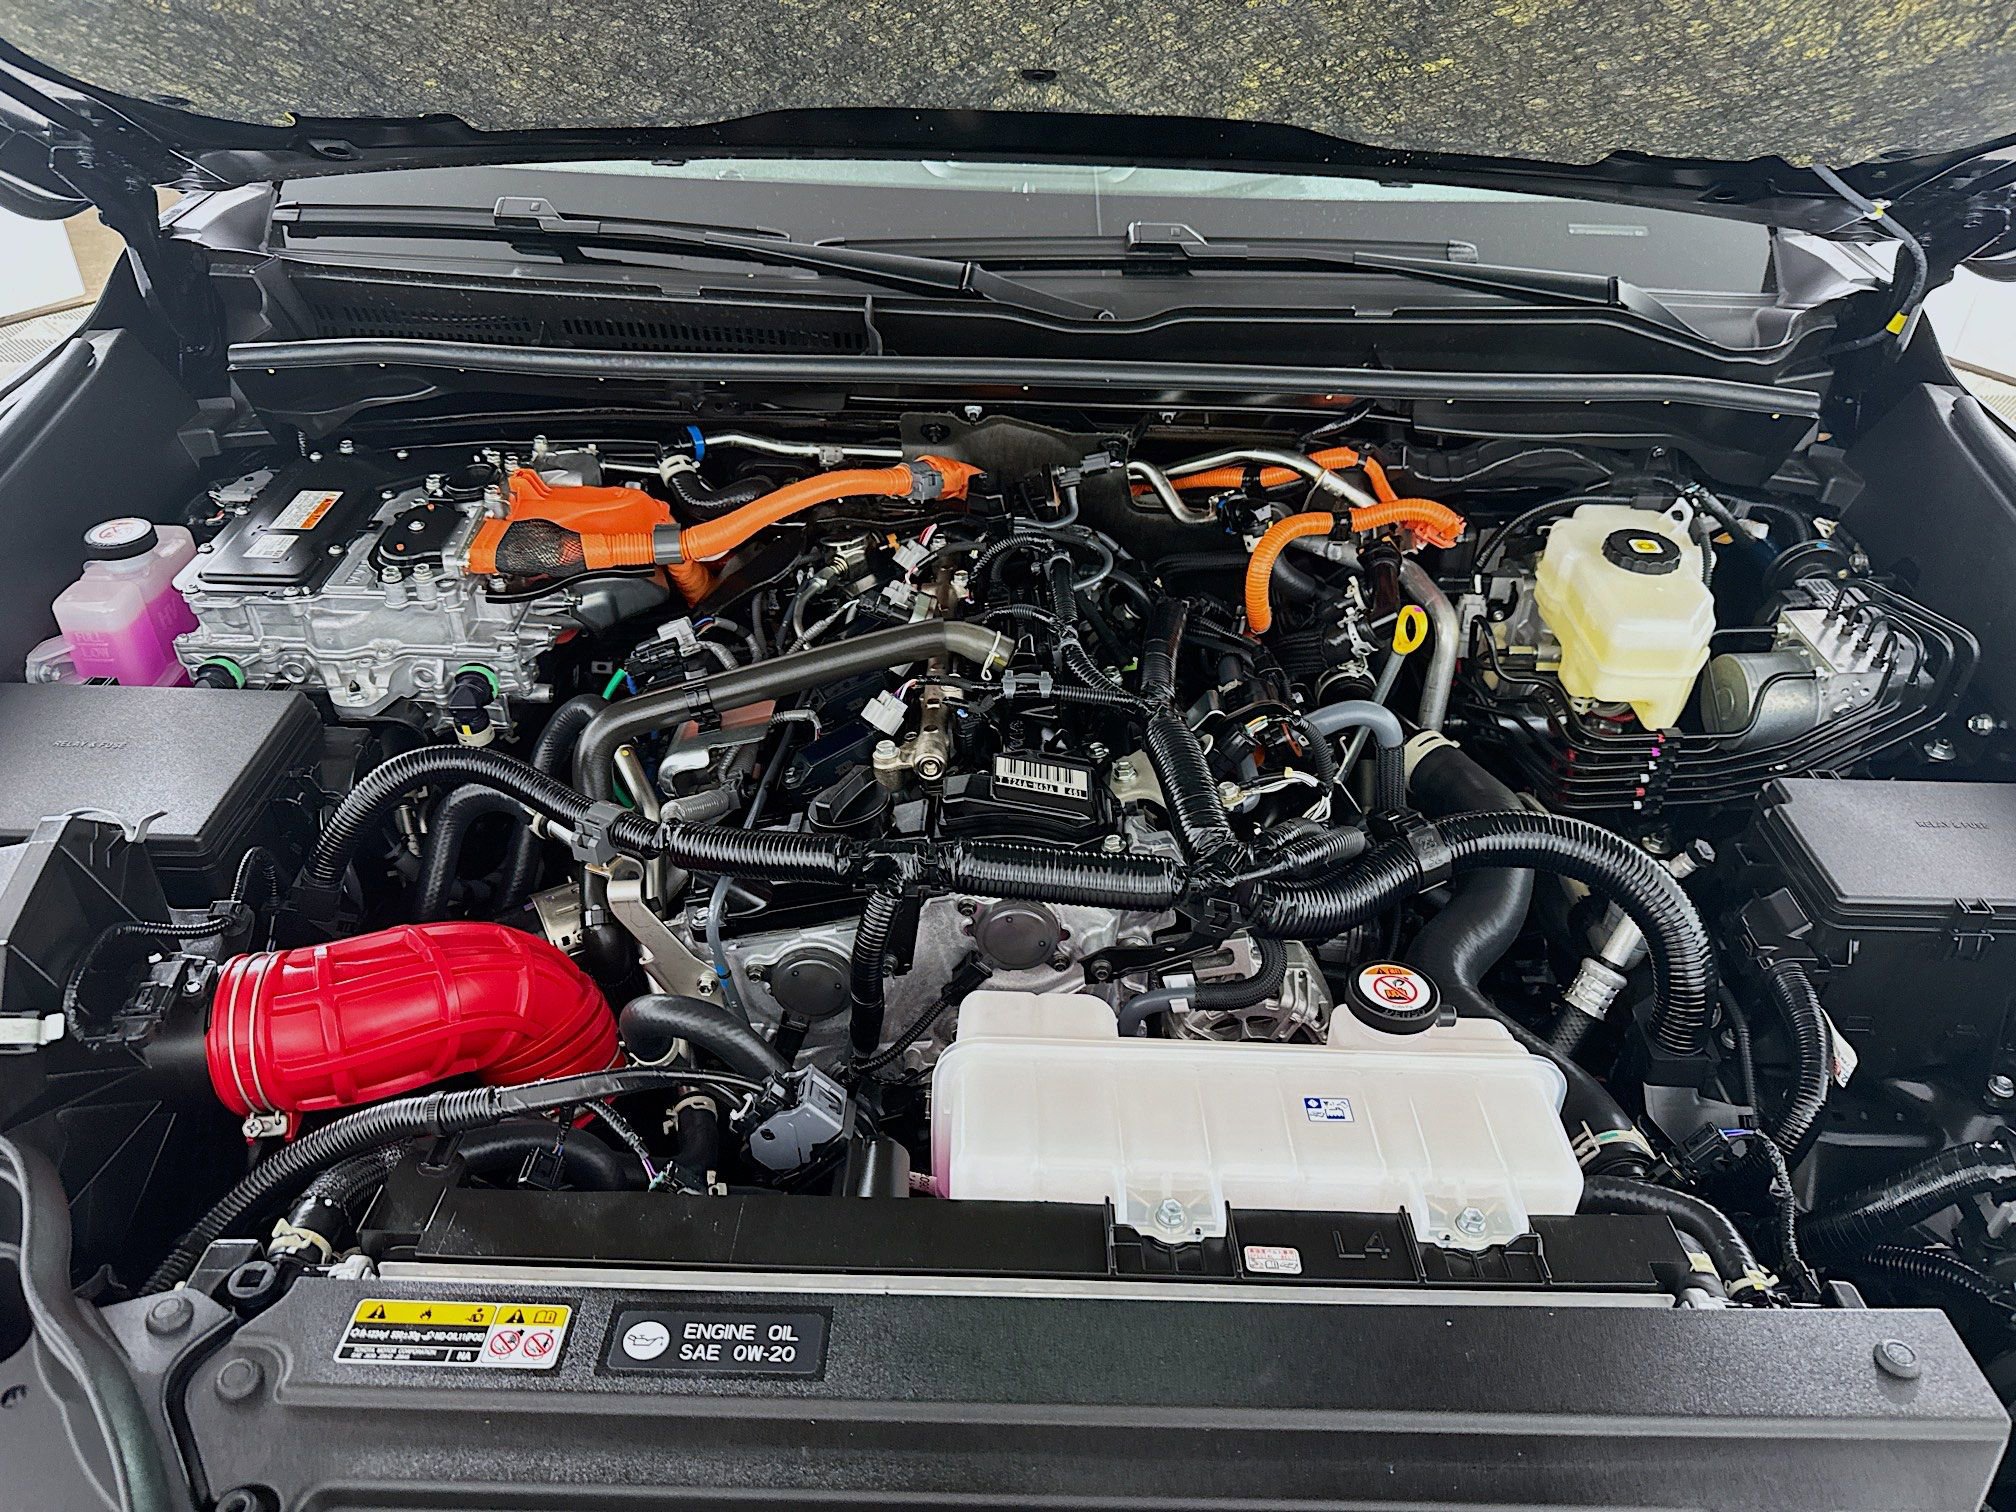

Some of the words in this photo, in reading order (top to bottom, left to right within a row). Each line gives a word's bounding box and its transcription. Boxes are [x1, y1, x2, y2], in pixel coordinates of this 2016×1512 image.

[52, 740, 89, 748] RELAY
[98, 742, 127, 750] FUSE
[1332, 1230, 1391, 1260] L4
[683, 1323, 757, 1341] ENGINE
[768, 1325, 799, 1342] OIL
[456, 1351, 472, 1362] NA
[679, 1343, 722, 1361] SAE
[733, 1345, 796, 1363] 0W-20
